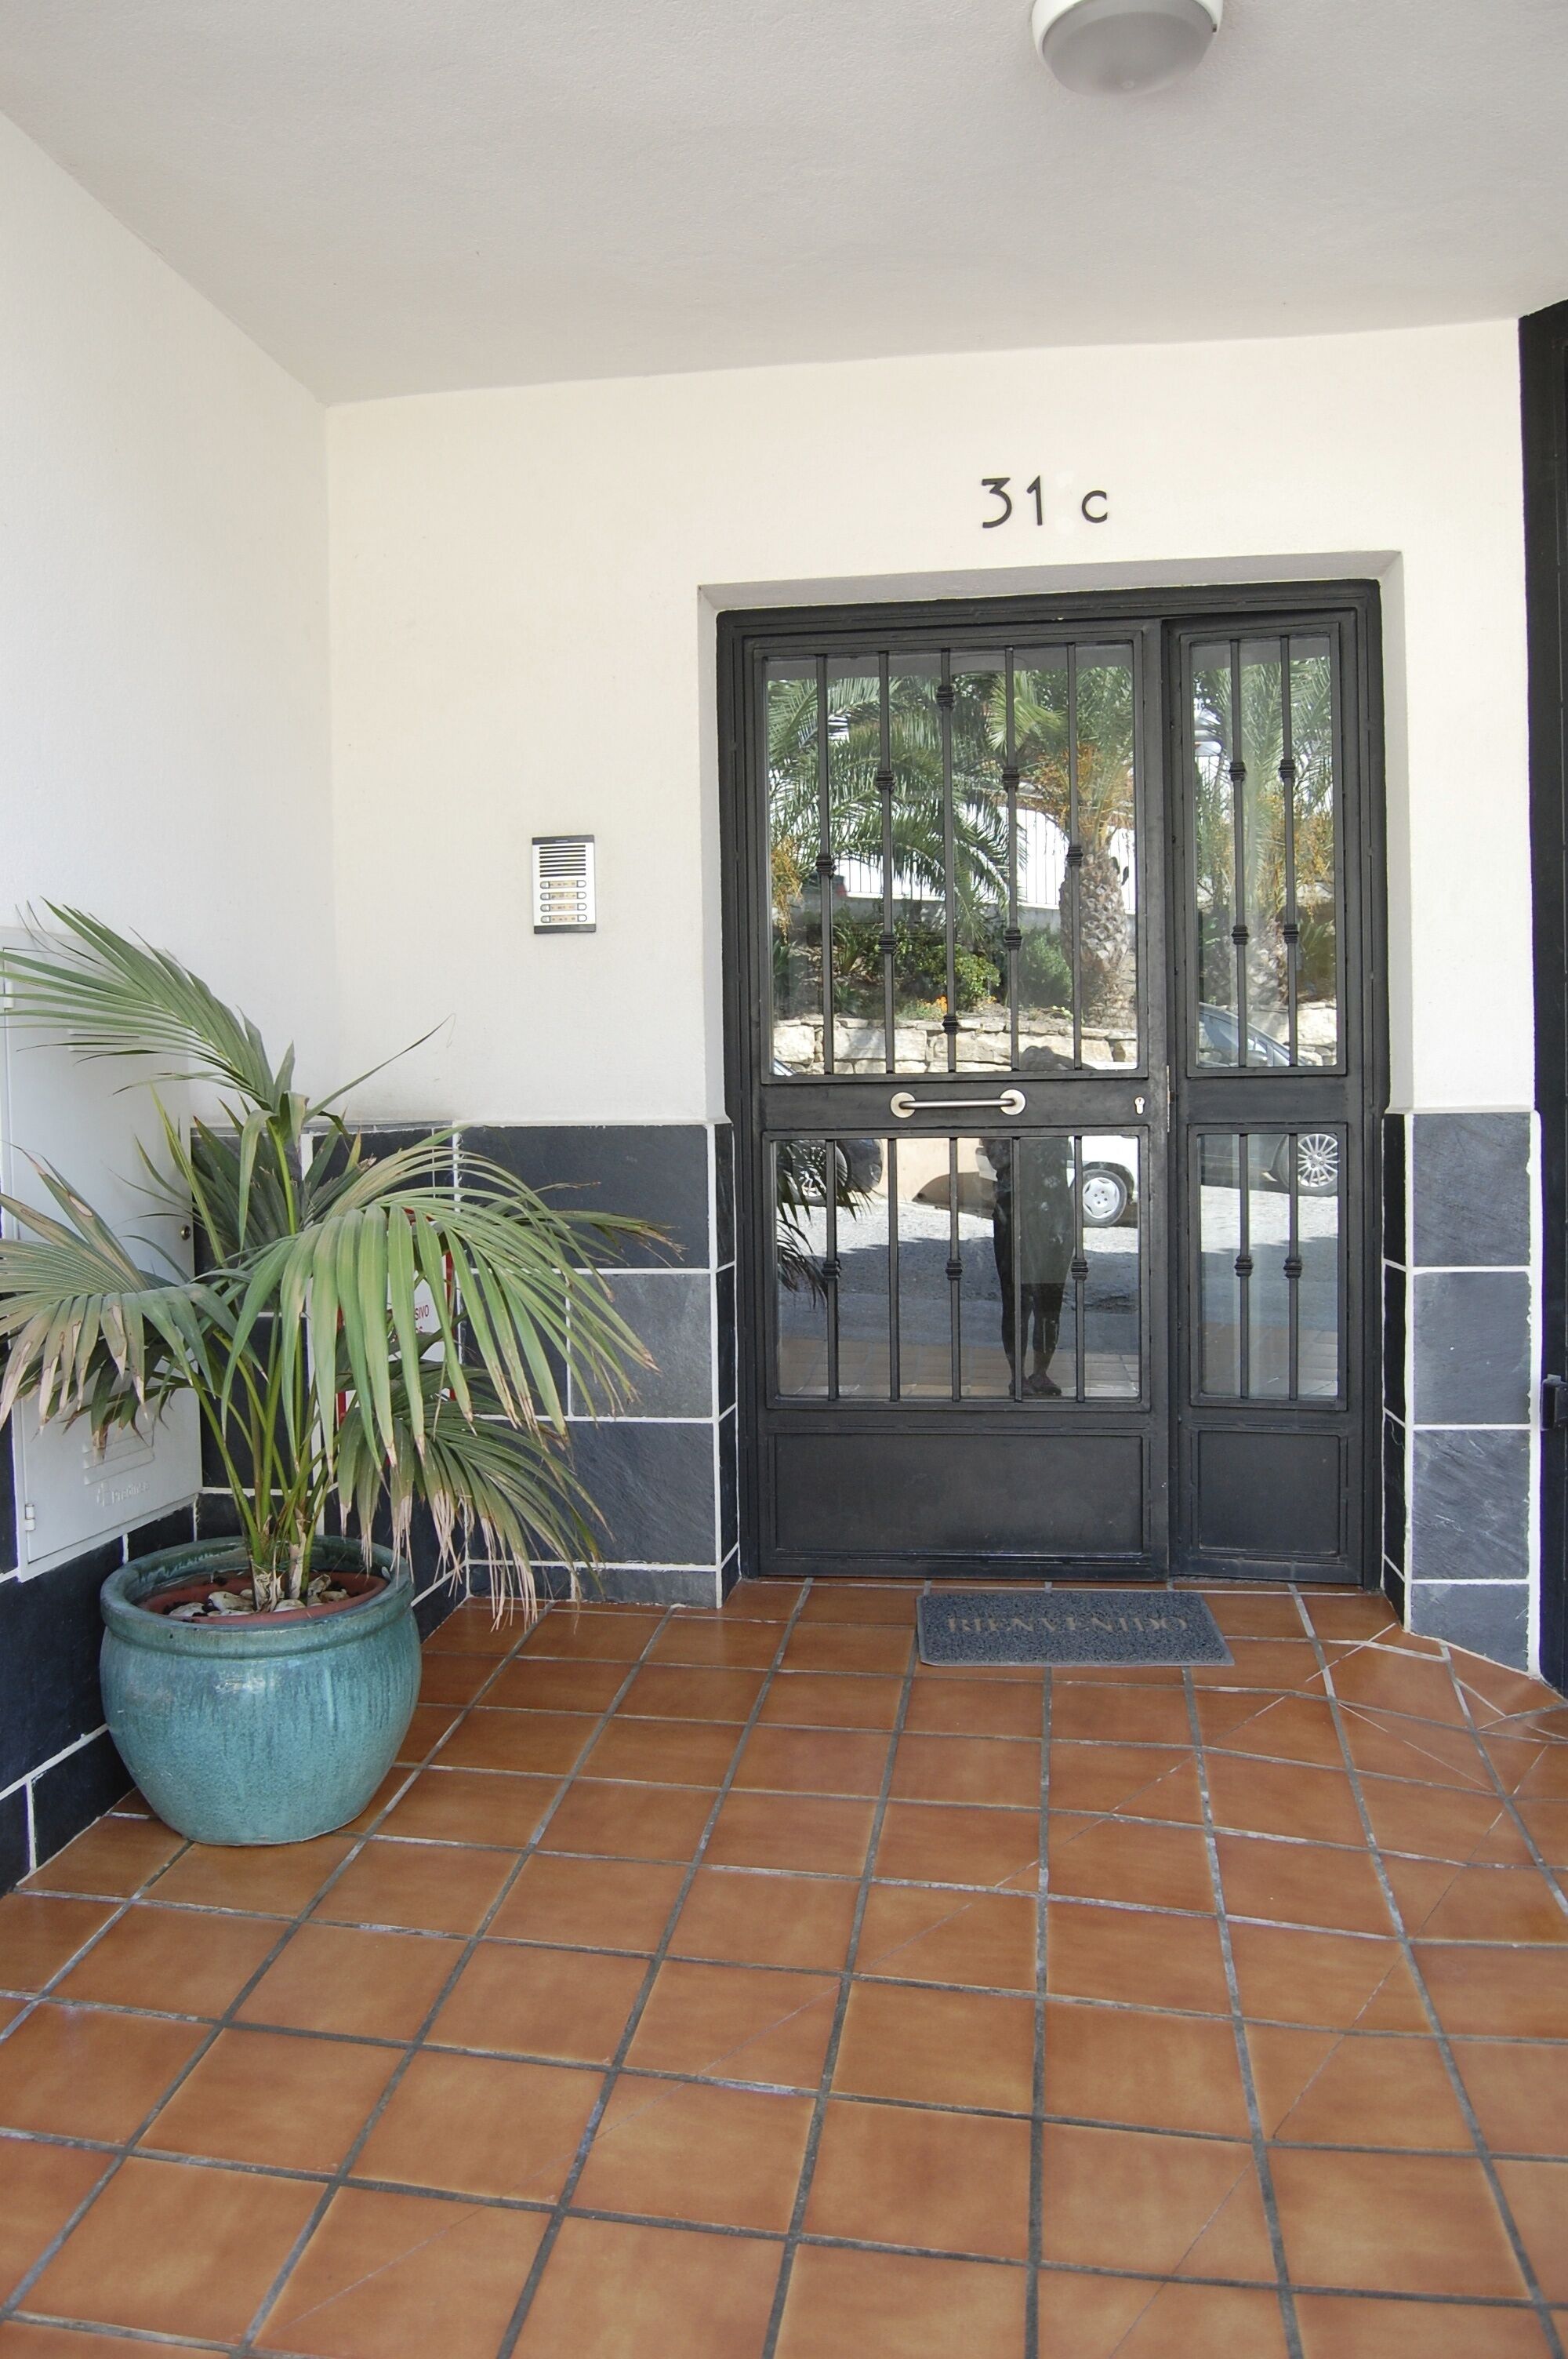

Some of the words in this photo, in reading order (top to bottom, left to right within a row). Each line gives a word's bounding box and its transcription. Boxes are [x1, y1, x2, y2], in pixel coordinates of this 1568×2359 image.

[982, 474, 1043, 529] 31
[414, 1304, 429, 1321] SIVO
[946, 1616, 1189, 1633] BIENVENIDO
